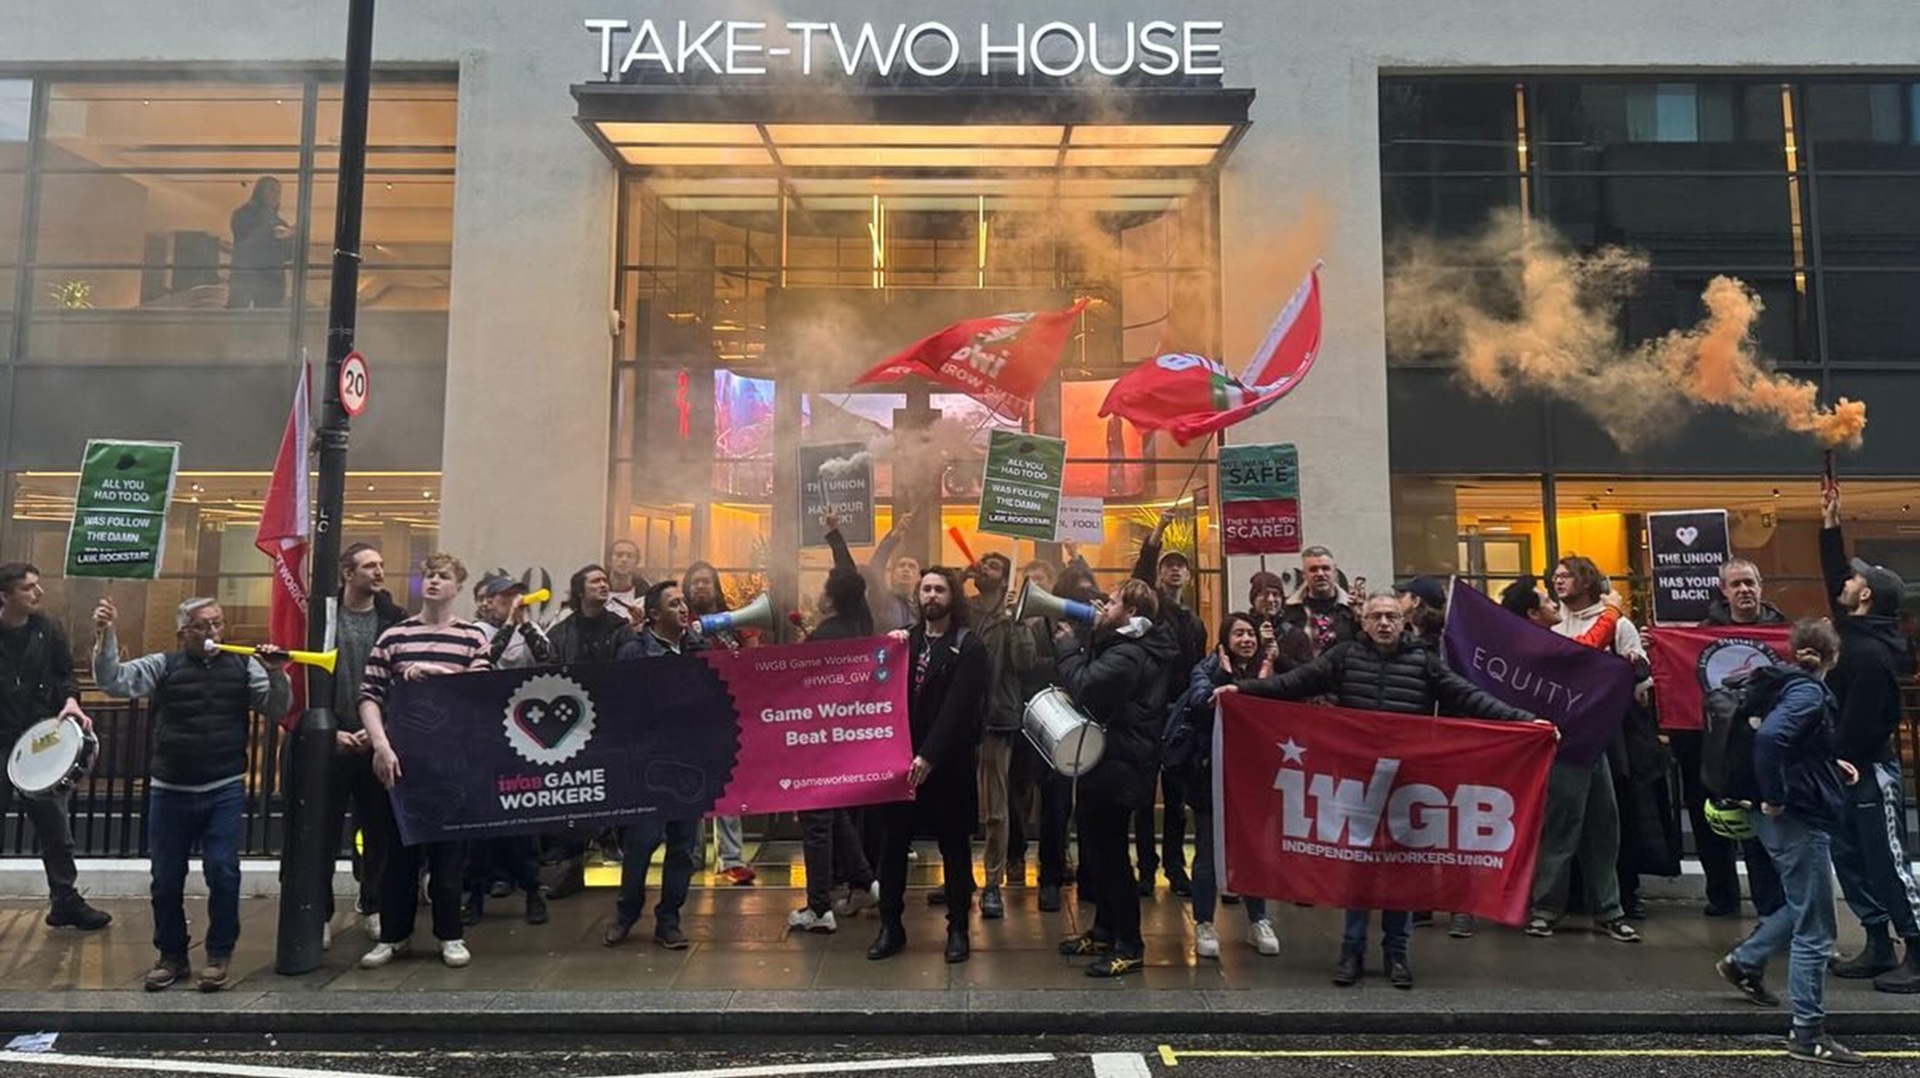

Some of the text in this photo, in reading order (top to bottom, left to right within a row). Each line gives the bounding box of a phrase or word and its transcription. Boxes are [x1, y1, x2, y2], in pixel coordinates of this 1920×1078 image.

[585, 19, 1224, 76] TAKE-TWO HOUSE
[345, 370, 364, 398] 20
[1007, 459, 1044, 471] ALL YOU
[1242, 460, 1271, 468] WANT
[1275, 458, 1294, 467] YOU
[1001, 466, 1048, 480] HAD TO DO
[1229, 467, 1288, 484] SAFE
[102, 479, 144, 490] ALL YOU
[829, 479, 865, 490] UNION
[992, 484, 1050, 499] WAS FOLLOW
[94, 491, 149, 502] HAD TO DO
[996, 496, 1041, 511] THE DAMN
[84, 516, 150, 527] WAS FOLLOW
[1278, 516, 1296, 524] YOU
[87, 531, 139, 542] THE DAMN
[1226, 524, 1295, 538] SCARED
[1657, 552, 1722, 563] THE UNION
[1659, 577, 1720, 587] HAS YOUR
[1671, 589, 1710, 600] BACK!
[789, 658, 821, 669] Game
[824, 653, 869, 665] Workers
[804, 672, 871, 687] @IWGB_GW
[1472, 647, 1583, 711] EQUITY
[761, 700, 893, 722] Game Workers
[786, 726, 893, 746] Beat Bosses
[544, 768, 605, 788] GAME
[793, 770, 894, 789] gameworkers.co.uk
[500, 785, 605, 810] WORKERS
[1282, 839, 1504, 869] INDEPENDENT WORKERS UNION
